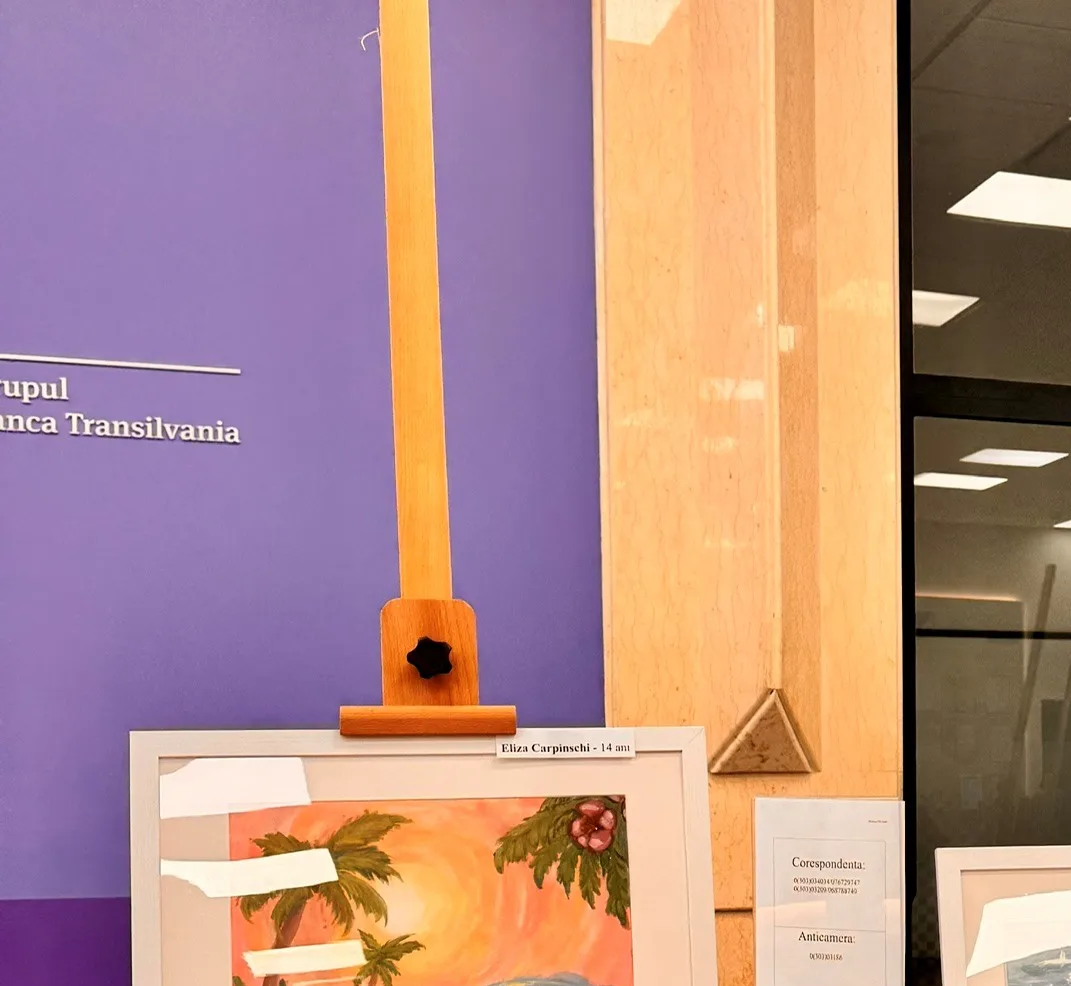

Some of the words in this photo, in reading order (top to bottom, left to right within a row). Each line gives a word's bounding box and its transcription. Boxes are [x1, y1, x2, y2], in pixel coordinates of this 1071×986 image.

[65, 412, 241, 444] Transilvania
[501, 743, 529, 753] Eliza
[531, 743, 590, 755] Carpinschi
[601, 743, 613, 753] 14
[791, 856, 866, 871] Corespondenta:
[798, 931, 856, 944] Anticamera:
